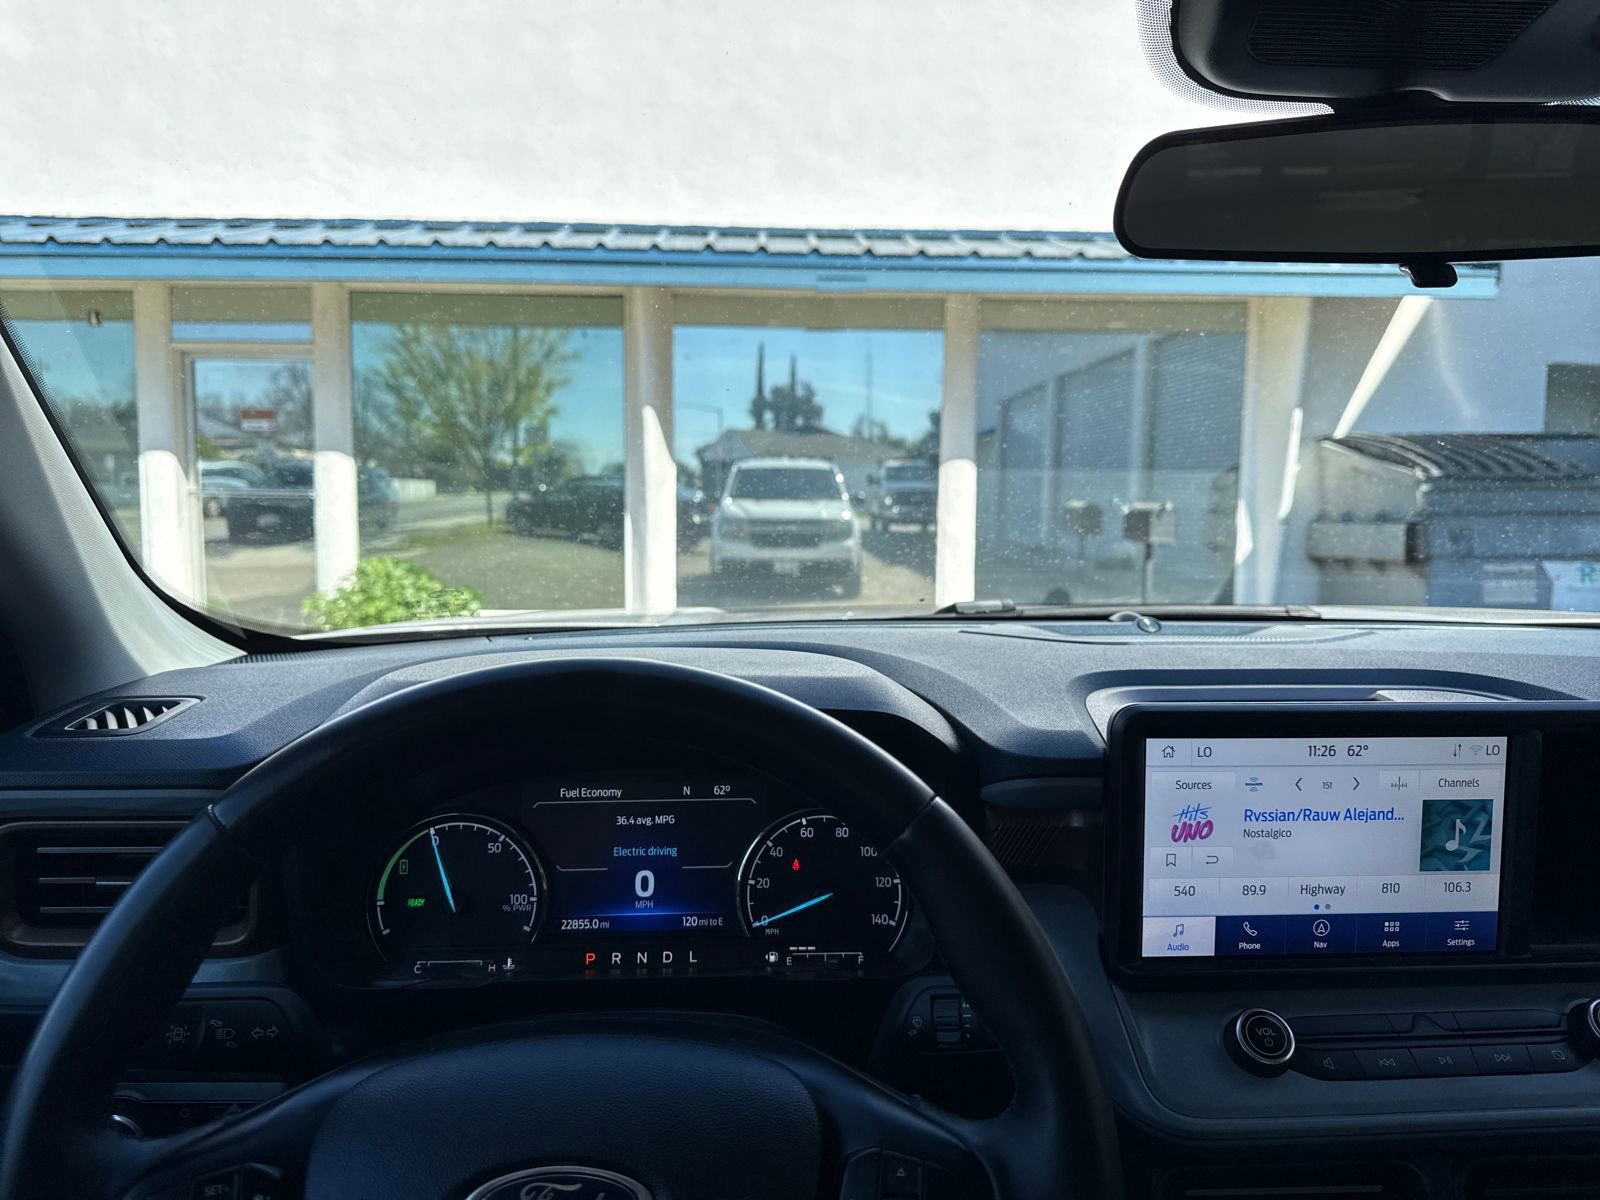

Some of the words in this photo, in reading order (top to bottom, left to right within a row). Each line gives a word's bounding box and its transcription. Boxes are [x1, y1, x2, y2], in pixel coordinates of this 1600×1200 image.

[1197, 746, 1212, 758] LO
[1308, 745, 1336, 757] 11:26
[1347, 745, 1369, 757] 62°
[1485, 745, 1500, 756] LO
[1175, 780, 1212, 790] Sources
[1322, 781, 1333, 789] 151
[1438, 778, 1480, 788] Channels
[560, 788, 580, 798] Fuel
[581, 787, 622, 799] Economy
[683, 786, 691, 796] N
[1174, 803, 1212, 823] Hits
[1243, 808, 1341, 823] Rvssian/Rauw
[1343, 807, 1405, 823] Alejand...
[616, 815, 635, 825] 36.4
[636, 817, 654, 827] avg.
[655, 815, 675, 825] MPG
[800, 827, 814, 838] 60
[835, 827, 849, 838] 80
[1171, 819, 1214, 843] UNO
[1243, 828, 1292, 840] Nostalgico
[487, 842, 502, 853] 50
[613, 846, 645, 857] Electric
[647, 846, 678, 858] driving
[769, 846, 783, 857] 40
[860, 846, 878, 857] 100
[634, 869, 655, 898] 0
[756, 878, 770, 888] 20
[875, 877, 892, 888] 120
[1381, 882, 1401, 893] 810
[1444, 882, 1472, 893] 106.3
[1174, 885, 1196, 897] 540
[1242, 884, 1266, 896] 89.9
[1300, 884, 1346, 896] Highway
[407, 898, 425, 907] READY
[509, 894, 528, 905] 100
[635, 900, 654, 909] MPH
[512, 904, 532, 912] PWR
[561, 919, 599, 930] 22855.0
[600, 920, 610, 929] mi
[682, 917, 698, 927] 120
[698, 918, 708, 926] mi
[709, 918, 718, 926] to
[718, 918, 724, 926] E
[871, 914, 889, 925] 140
[1167, 943, 1189, 951] Audio
[1238, 942, 1261, 950] Phone
[1382, 940, 1400, 948] Apps
[1447, 938, 1475, 947] Settings
[585, 953, 596, 965] P
[611, 952, 622, 964] R
[637, 952, 647, 964] N
[662, 951, 673, 963] D
[689, 951, 698, 963] L
[786, 957, 793, 966] E
[858, 955, 864, 964] F
[414, 965, 422, 974] C
[488, 964, 496, 973] H
[1255, 1027, 1277, 1036] VOL
